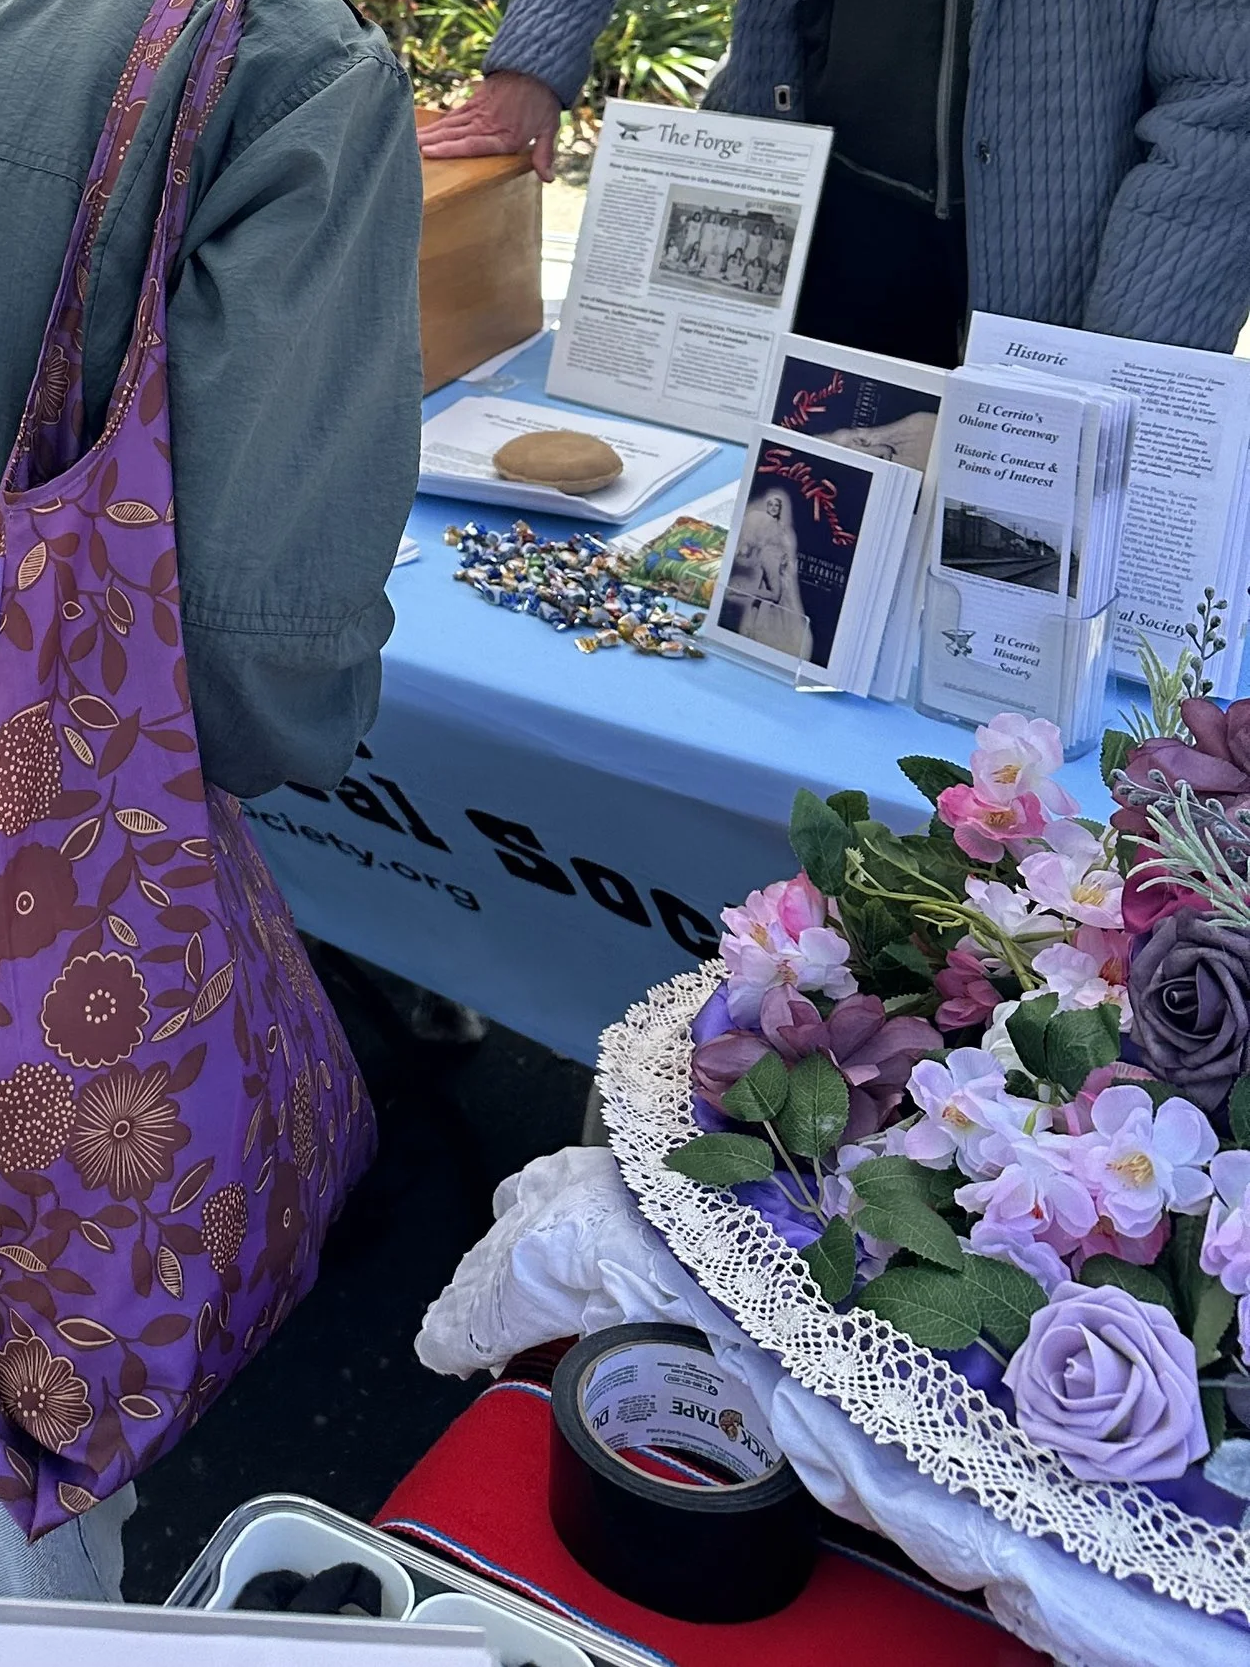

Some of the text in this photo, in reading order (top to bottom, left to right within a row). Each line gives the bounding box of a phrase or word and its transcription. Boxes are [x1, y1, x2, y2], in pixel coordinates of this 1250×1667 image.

[658, 124, 689, 147] The
[694, 129, 743, 159] Forge
[1005, 342, 1068, 367] Historic
[977, 402, 1044, 424] El Cerrito's
[958, 414, 1060, 444] Ohlone Greenway
[758, 449, 815, 494] Sally
[954, 443, 1058, 474] Historic Context &
[958, 459, 1054, 488] Points of Interest
[994, 634, 1005, 644] El
[1135, 613, 1187, 638] Society
[999, 662, 1032, 680] Society
[671, 1399, 718, 1429] TAPE
